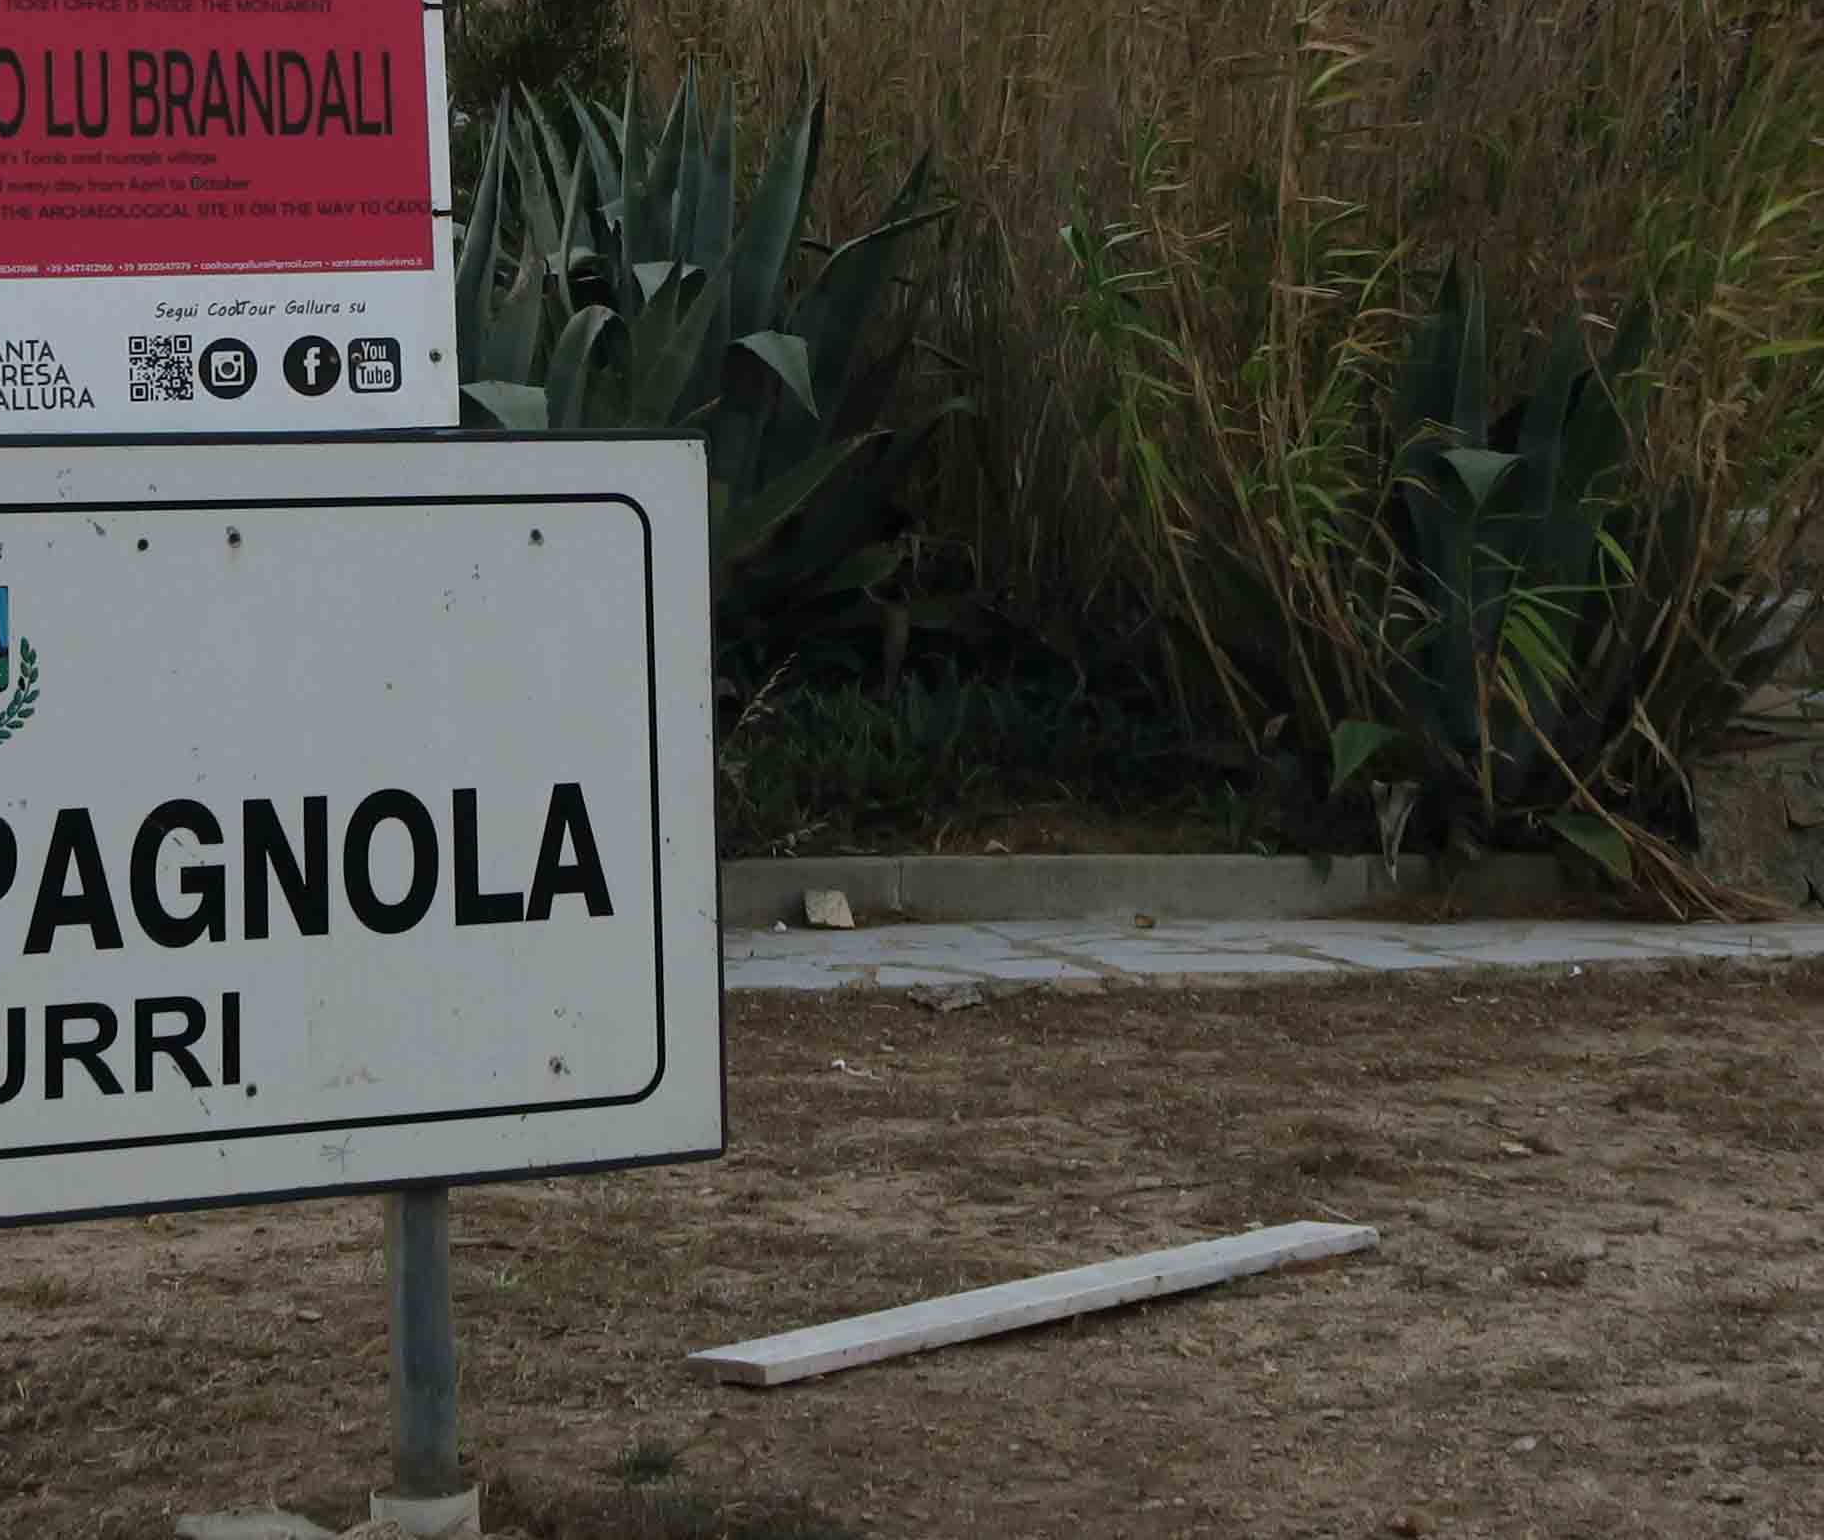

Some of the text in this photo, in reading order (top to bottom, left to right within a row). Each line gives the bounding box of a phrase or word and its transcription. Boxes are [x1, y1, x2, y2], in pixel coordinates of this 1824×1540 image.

[44, 49, 111, 139] LU
[129, 49, 395, 138] BRANDALI
[154, 302, 198, 322] Segui
[284, 299, 341, 316] Gallura
[348, 300, 368, 315] su
[360, 340, 388, 360] You
[358, 364, 393, 386] Tube
